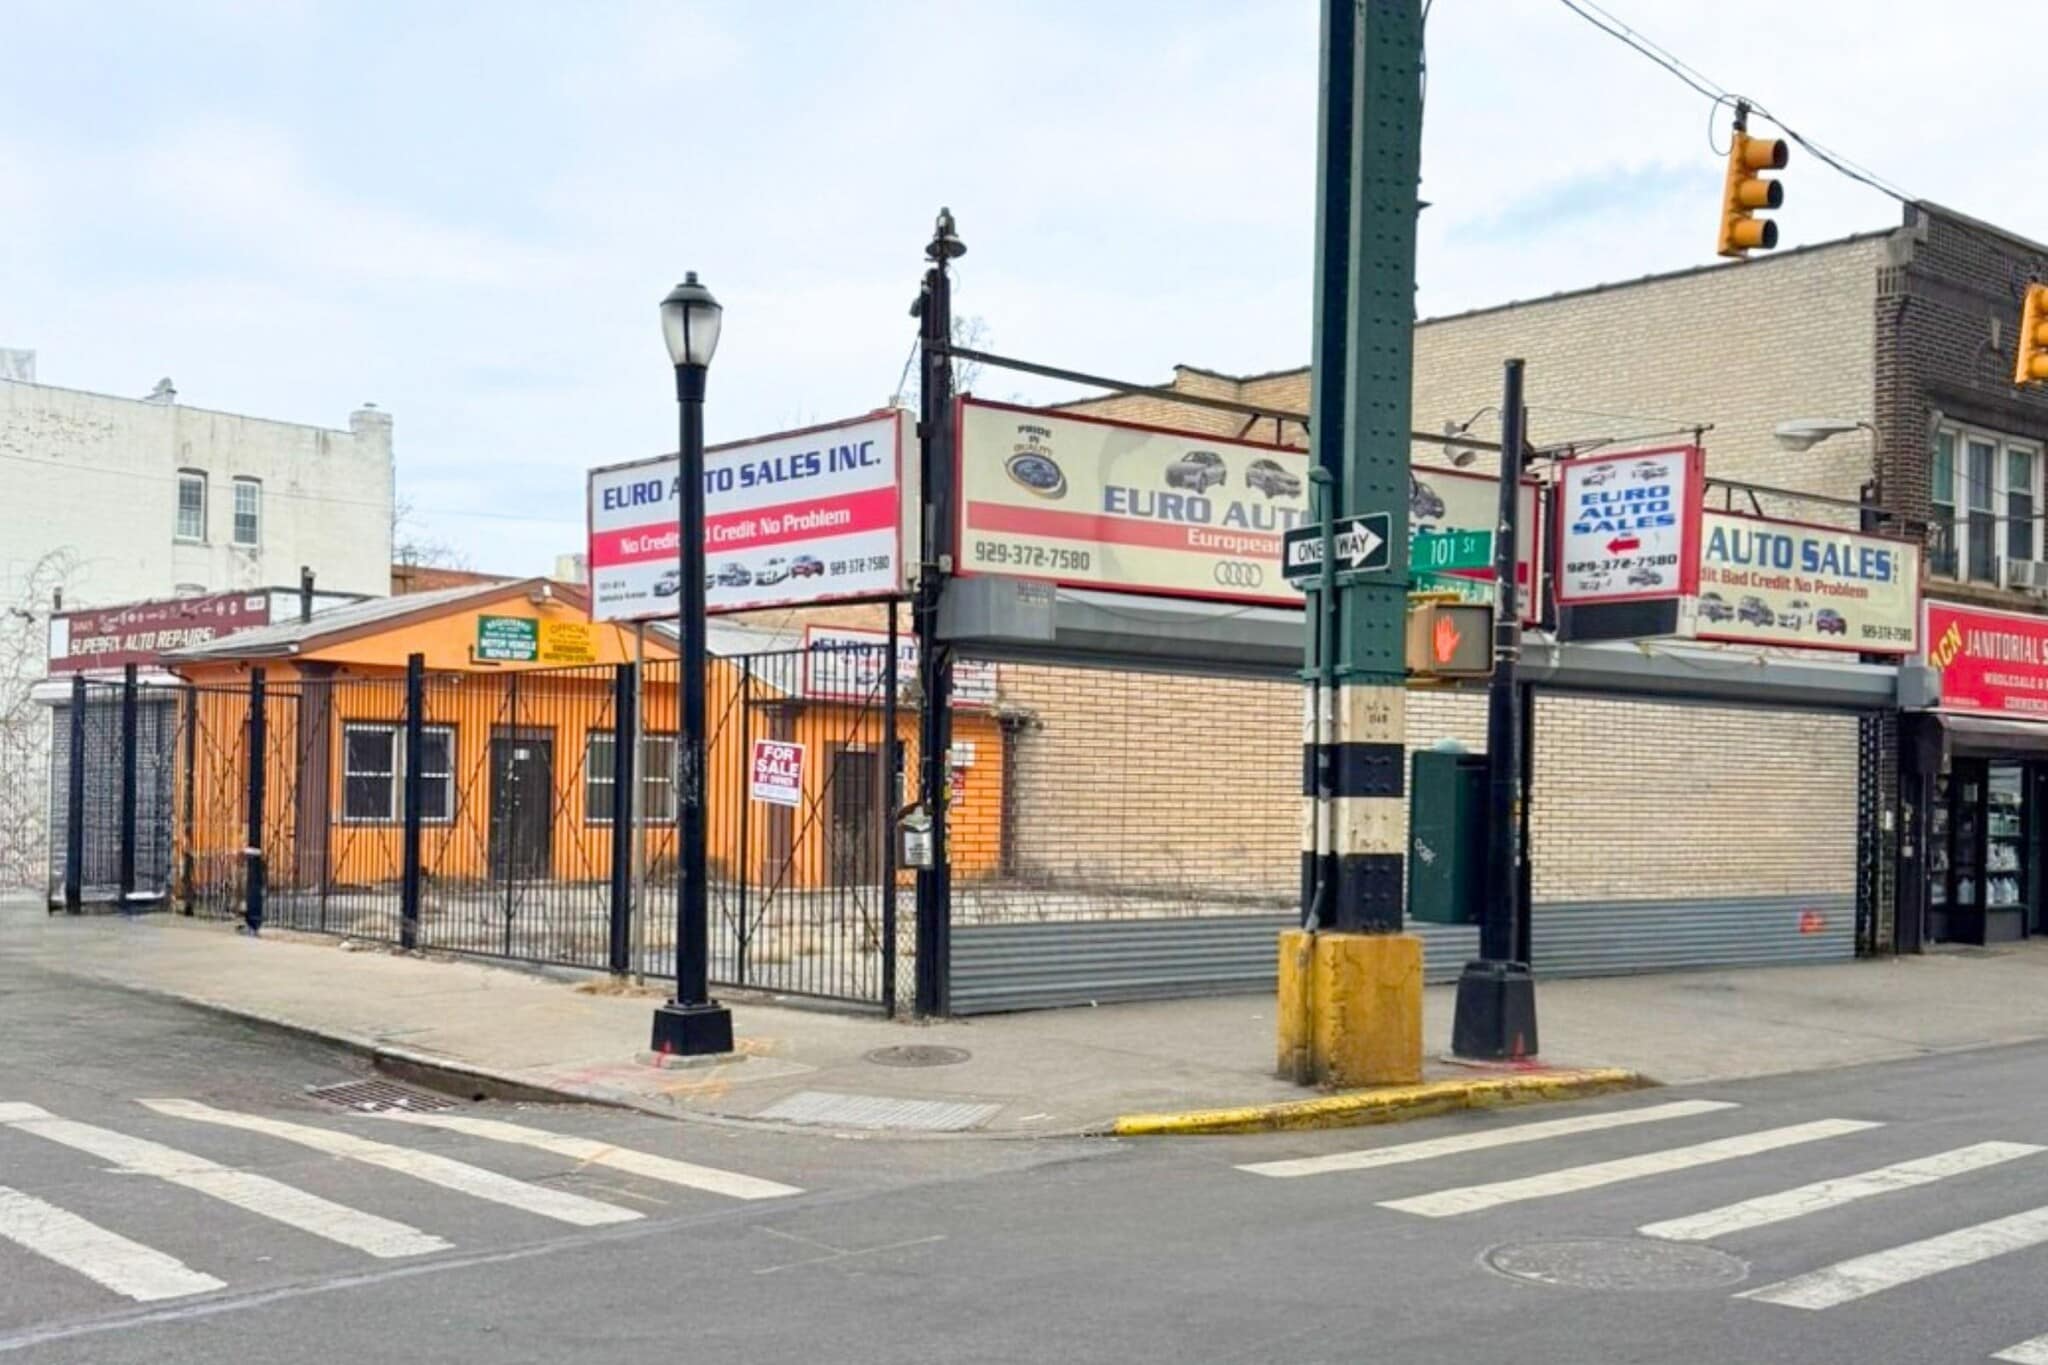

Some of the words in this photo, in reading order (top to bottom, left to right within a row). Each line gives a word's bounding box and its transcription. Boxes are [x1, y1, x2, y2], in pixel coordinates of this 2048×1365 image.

[1017, 425, 1051, 438] PRIDE
[602, 478, 663, 511] EURO
[668, 466, 734, 501] ATO
[740, 451, 821, 489] SALES
[828, 439, 882, 473] INC.
[1103, 484, 1212, 524] EURO
[1222, 500, 1309, 531] AUT
[1581, 484, 1671, 506] EURO
[1571, 513, 1676, 535] SALES
[1578, 500, 1670, 521] AUTO
[713, 521, 757, 544] Credit
[760, 516, 781, 536] No
[783, 507, 851, 534] Problem
[620, 536, 639, 555] No
[639, 530, 680, 554] Credit
[975, 541, 1091, 572] 929-372-7580
[1298, 541, 1324, 563] ONE
[1337, 533, 1370, 556] WAY
[1430, 537, 1456, 566] 101
[1705, 525, 1794, 571] AUTO
[1801, 538, 1892, 582] SALES
[1721, 569, 1748, 587] Bad
[1751, 572, 1791, 591] Credit
[1793, 577, 1812, 593] No
[1814, 582, 1869, 600] Problem
[123, 631, 156, 652] AUTO
[156, 627, 212, 649] REPAIRS
[1965, 628, 2040, 666] JANITORIAL
[763, 744, 795, 762] FOR
[756, 758, 800, 778] SALE
